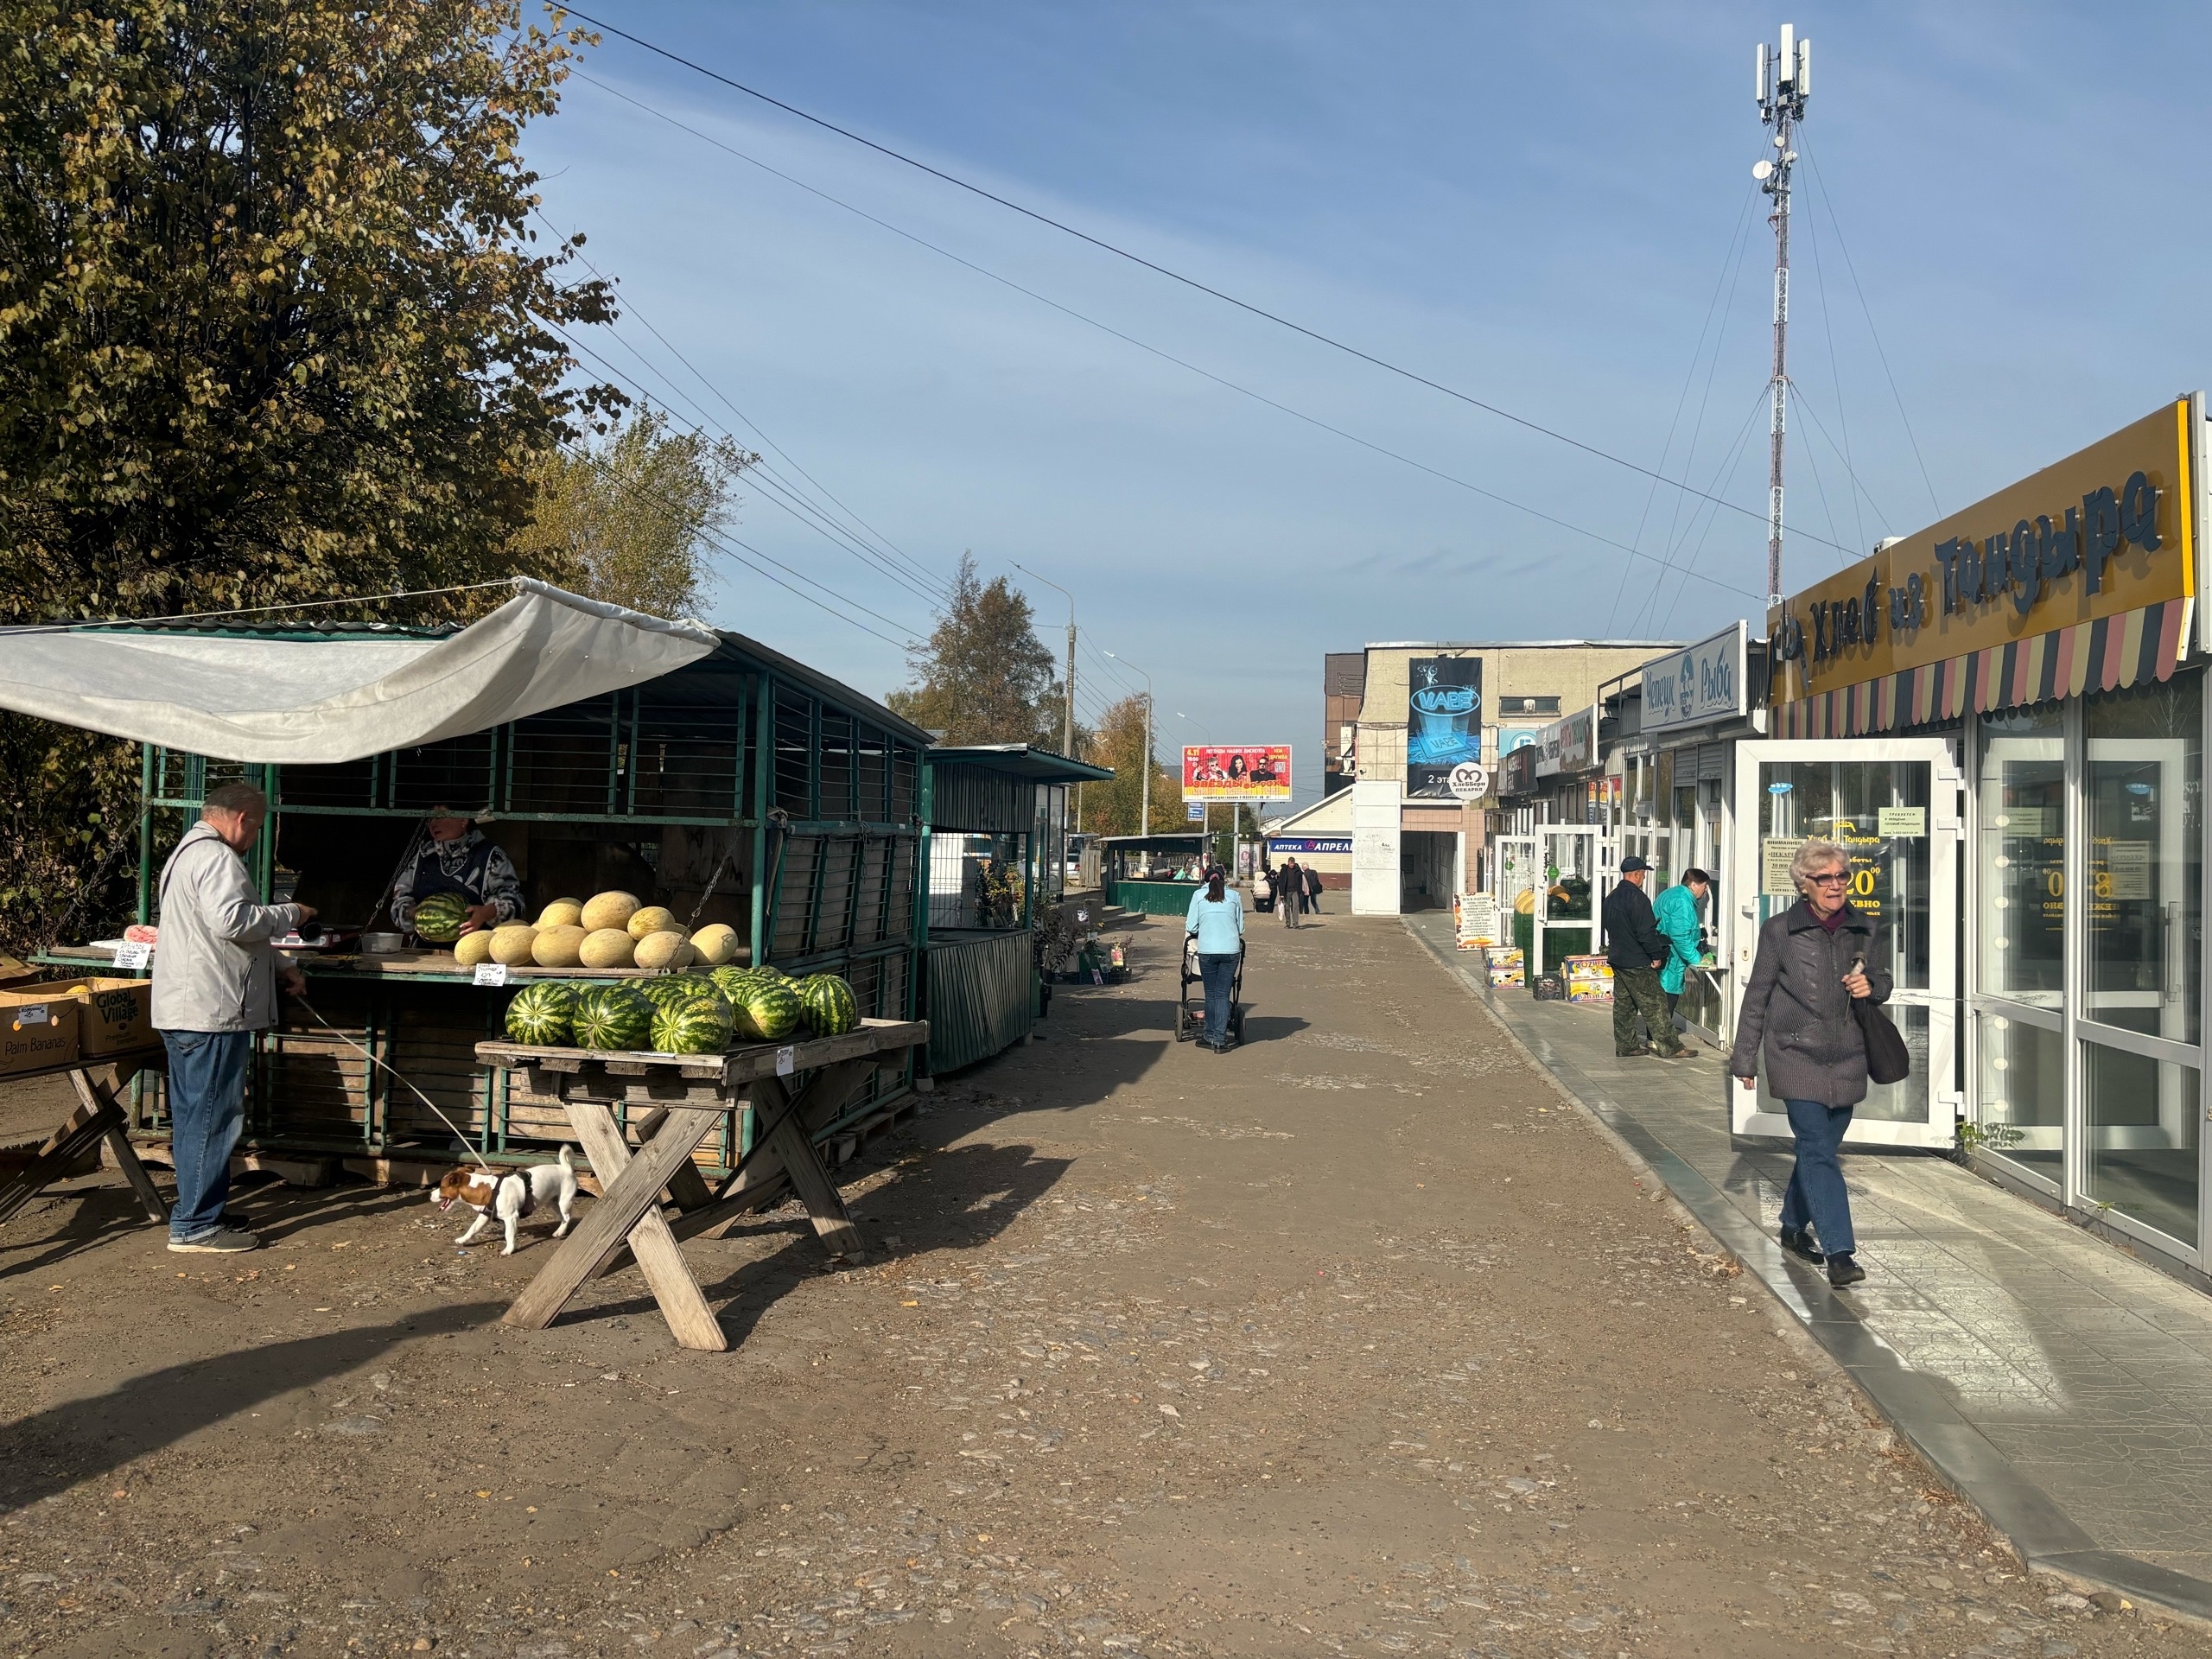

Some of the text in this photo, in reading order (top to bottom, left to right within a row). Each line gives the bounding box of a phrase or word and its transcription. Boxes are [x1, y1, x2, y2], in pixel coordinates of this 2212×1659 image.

[1889, 572, 1922, 630] из
[1935, 471, 2162, 617] Тандыра
[1645, 644, 1732, 718] Чепецк Рыба
[1418, 691, 1472, 710] VAPE
[1427, 775, 1434, 784] 2
[1843, 835, 1880, 846] Тандыра
[96, 988, 135, 1009] Global
[5, 1037, 66, 1056] Palm Bananas
